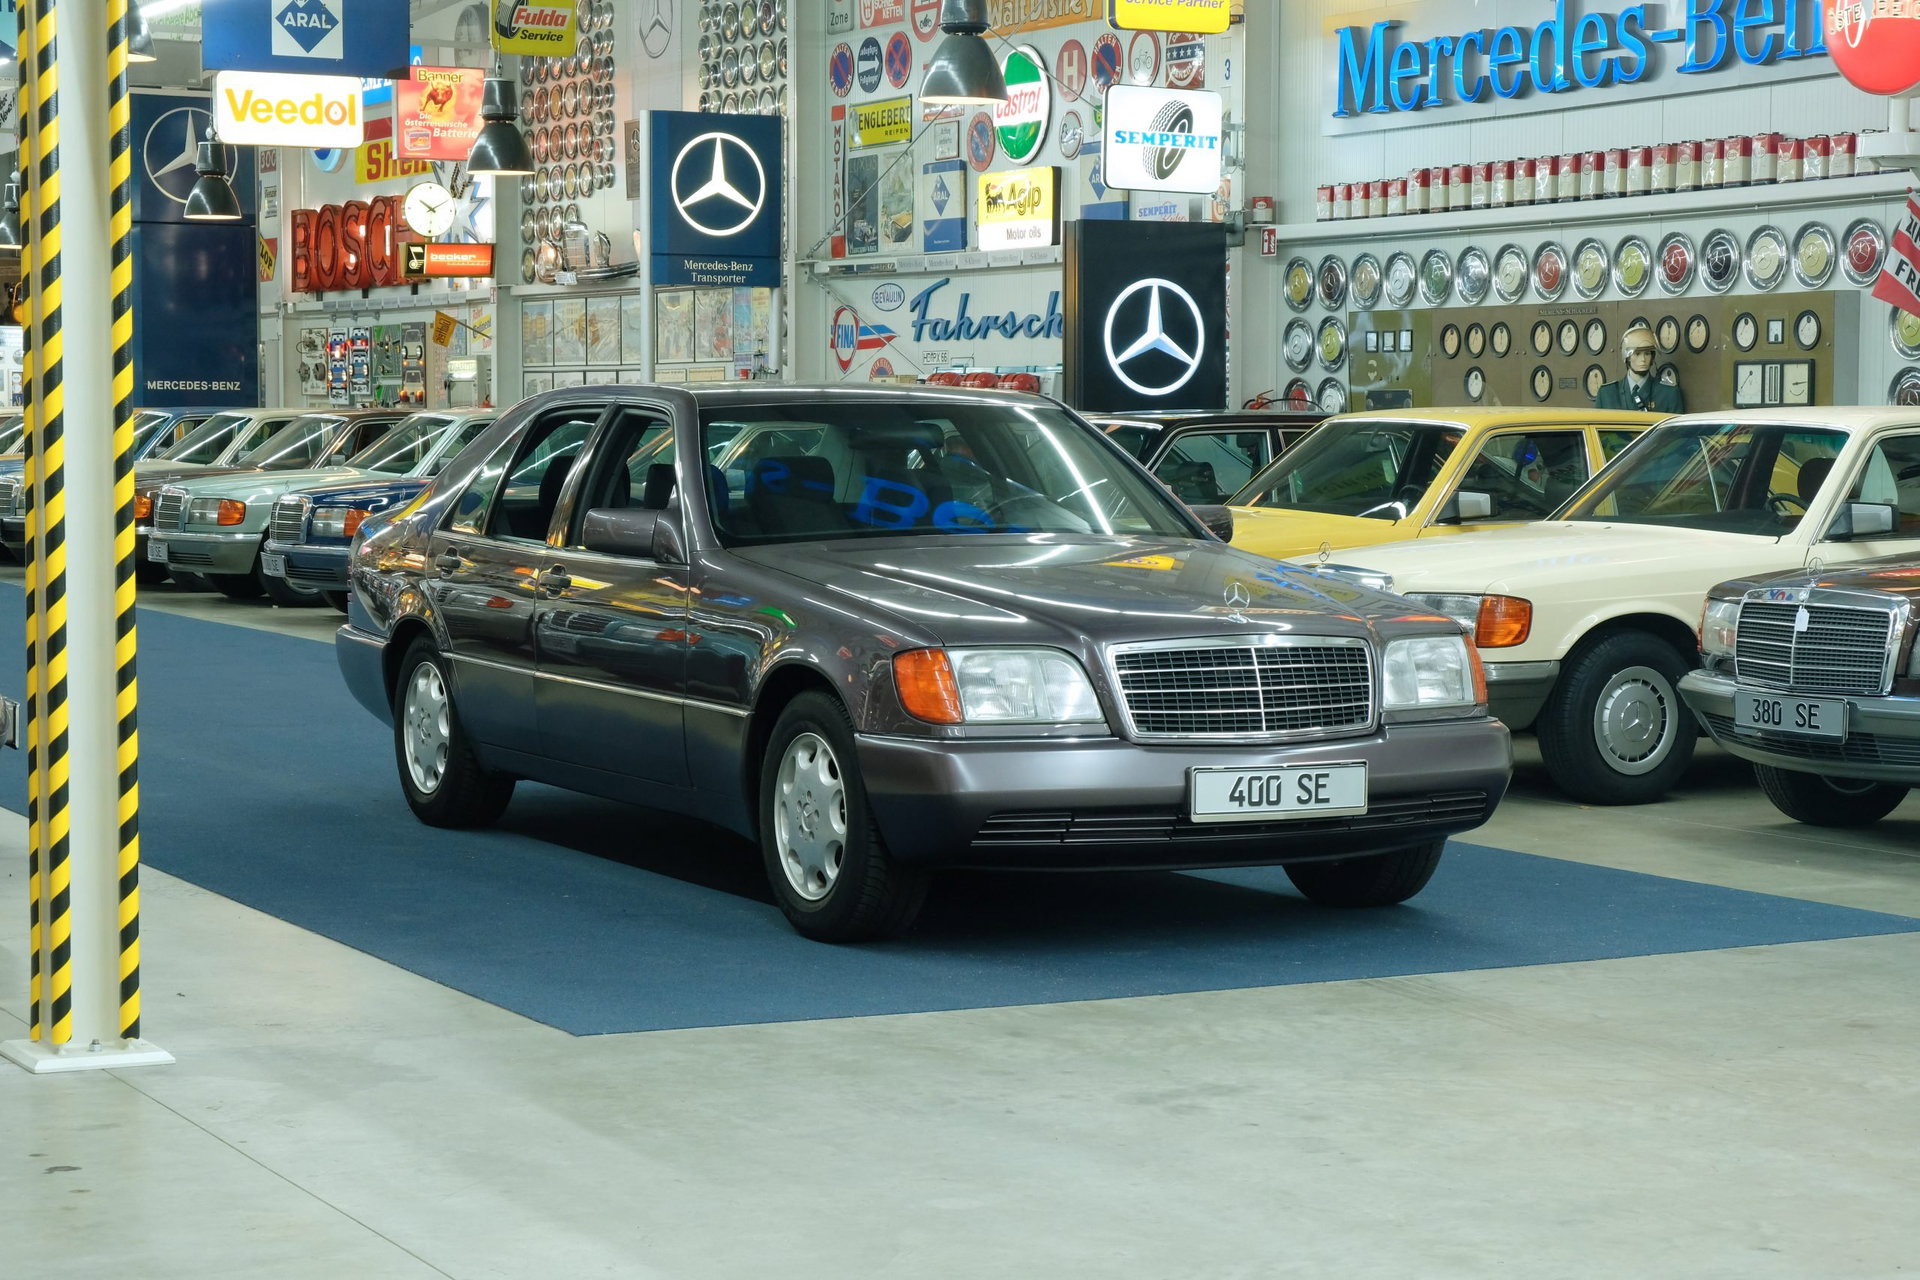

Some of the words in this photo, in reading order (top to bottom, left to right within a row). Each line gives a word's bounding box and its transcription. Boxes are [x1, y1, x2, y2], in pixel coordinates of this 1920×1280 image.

[283, 11, 331, 29] ARAL
[513, 8, 568, 27] Fulda
[830, 12, 849, 26] Zone
[520, 29, 563, 42] Service
[1332, 0, 1828, 118] Mercedes-Ben
[418, 69, 463, 83] Banner
[1063, 50, 1078, 91] H
[1224, 59, 1231, 80] 3
[225, 88, 356, 126] Veedol
[419, 112, 433, 120] Die
[858, 106, 910, 130] ENGLEBERT
[884, 128, 908, 136] REIFEN
[1115, 130, 1218, 149] SEMPERIT
[833, 125, 841, 231] MOTANOL
[933, 191, 949, 201] ARAL
[1006, 182, 1041, 215] Agip
[1138, 204, 1177, 218] SEMPERIT
[1006, 229, 1026, 241] Motor
[1028, 226, 1041, 238] oils
[430, 253, 476, 261] becker
[684, 260, 753, 271] Mercedes-Benz
[691, 272, 746, 284] Transporter
[836, 324, 855, 349] FINA
[147, 381, 240, 391] MERCEDES-BENZ
[1752, 699, 1782, 726] 380
[1795, 703, 1820, 730] SE
[1229, 775, 1282, 807] 400
[1296, 773, 1331, 805] SE
